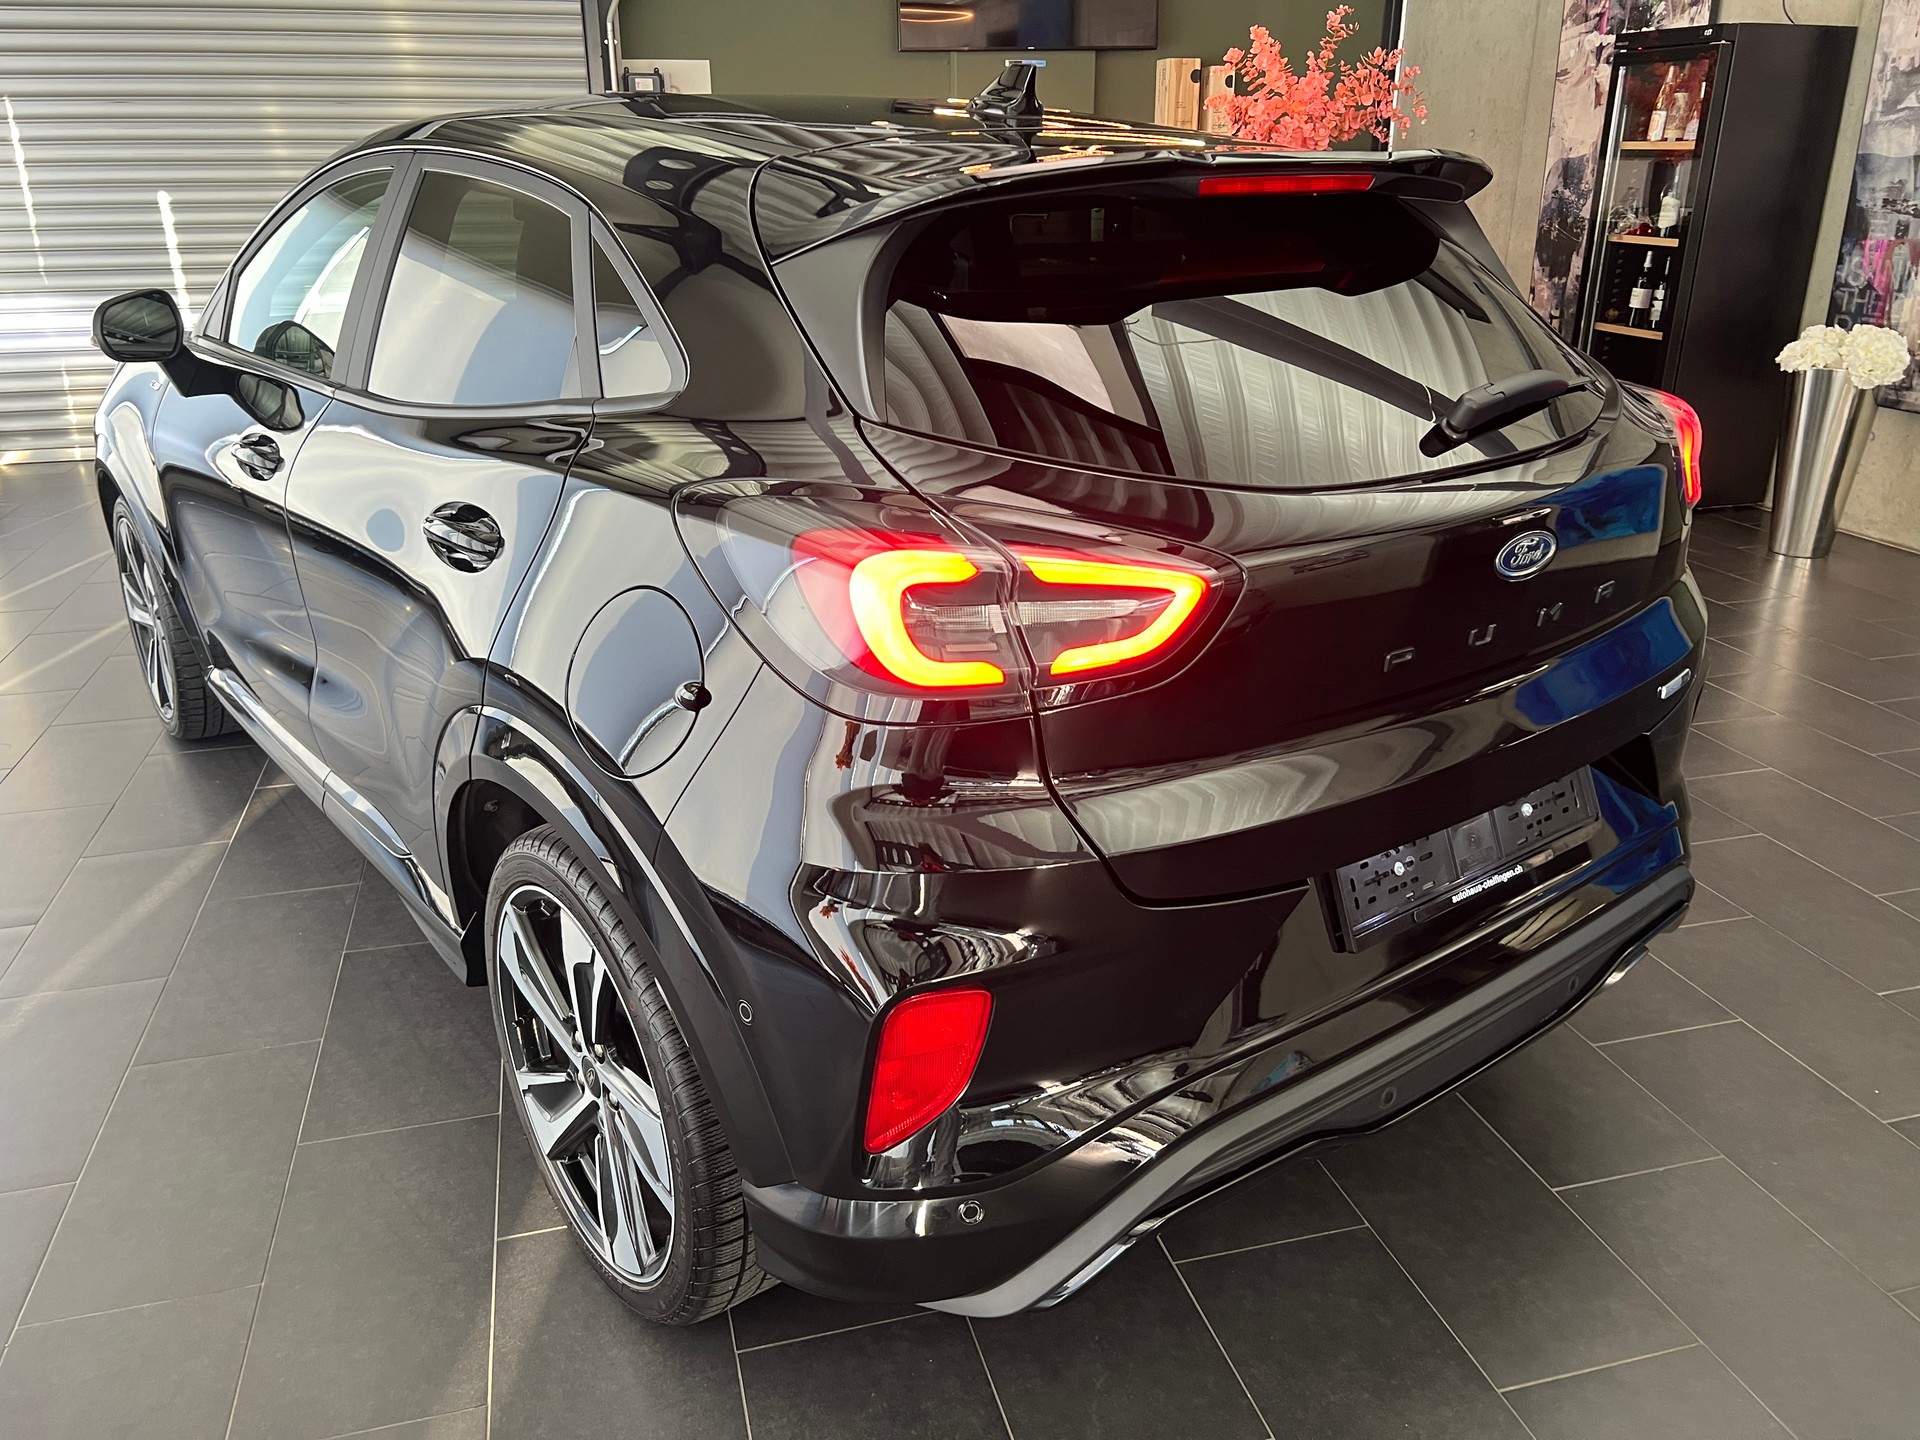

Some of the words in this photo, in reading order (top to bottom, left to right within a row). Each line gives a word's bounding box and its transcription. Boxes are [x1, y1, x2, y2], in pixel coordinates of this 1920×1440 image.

[1510, 537, 1545, 568] Ford
[1383, 580, 1616, 673] PUMA
[1451, 864, 1524, 904] autohaus-otelfingen.ch
